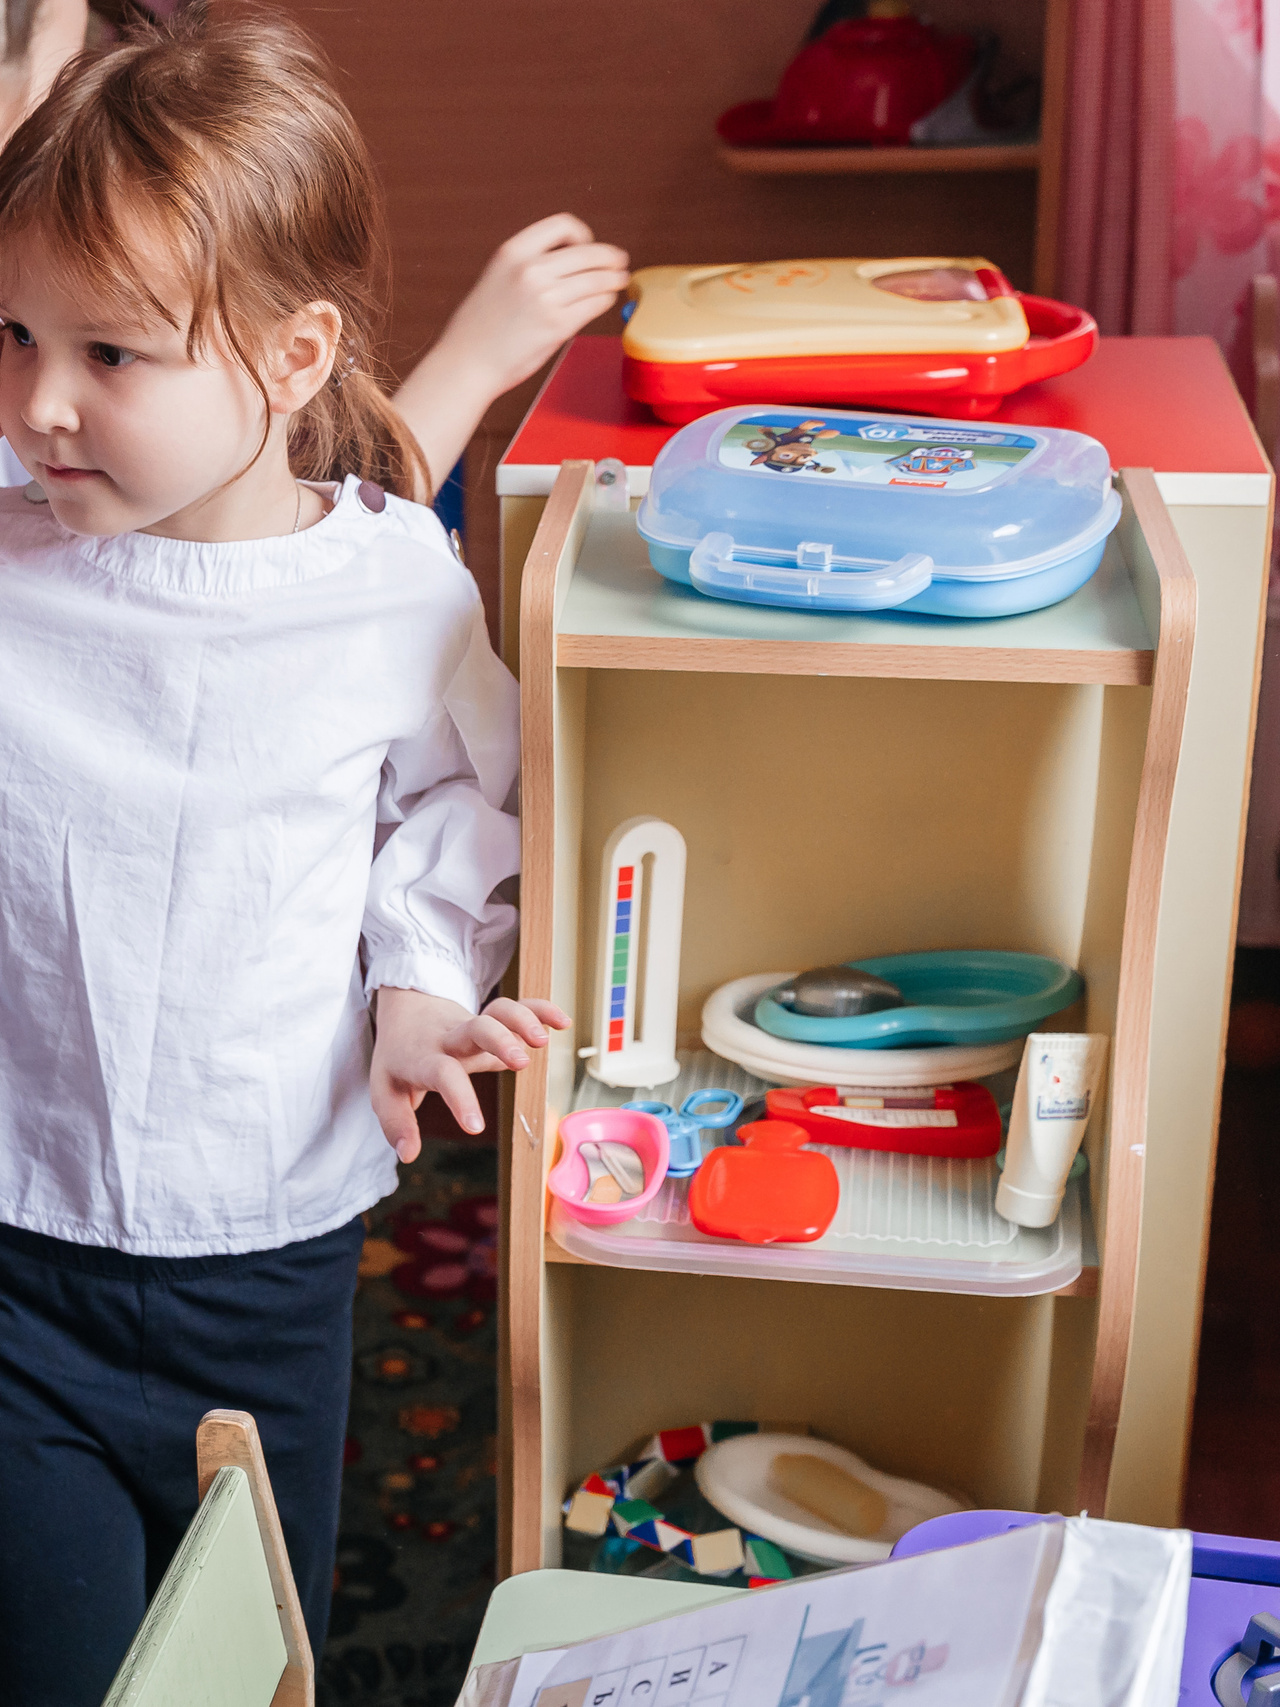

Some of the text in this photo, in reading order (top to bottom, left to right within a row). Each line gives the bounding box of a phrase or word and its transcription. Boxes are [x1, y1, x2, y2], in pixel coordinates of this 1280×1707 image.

[867, 428, 897, 439] 10
[887, 455, 976, 472] PAW
[708, 1661, 728, 1677] А
[632, 1680, 652, 1696] С
